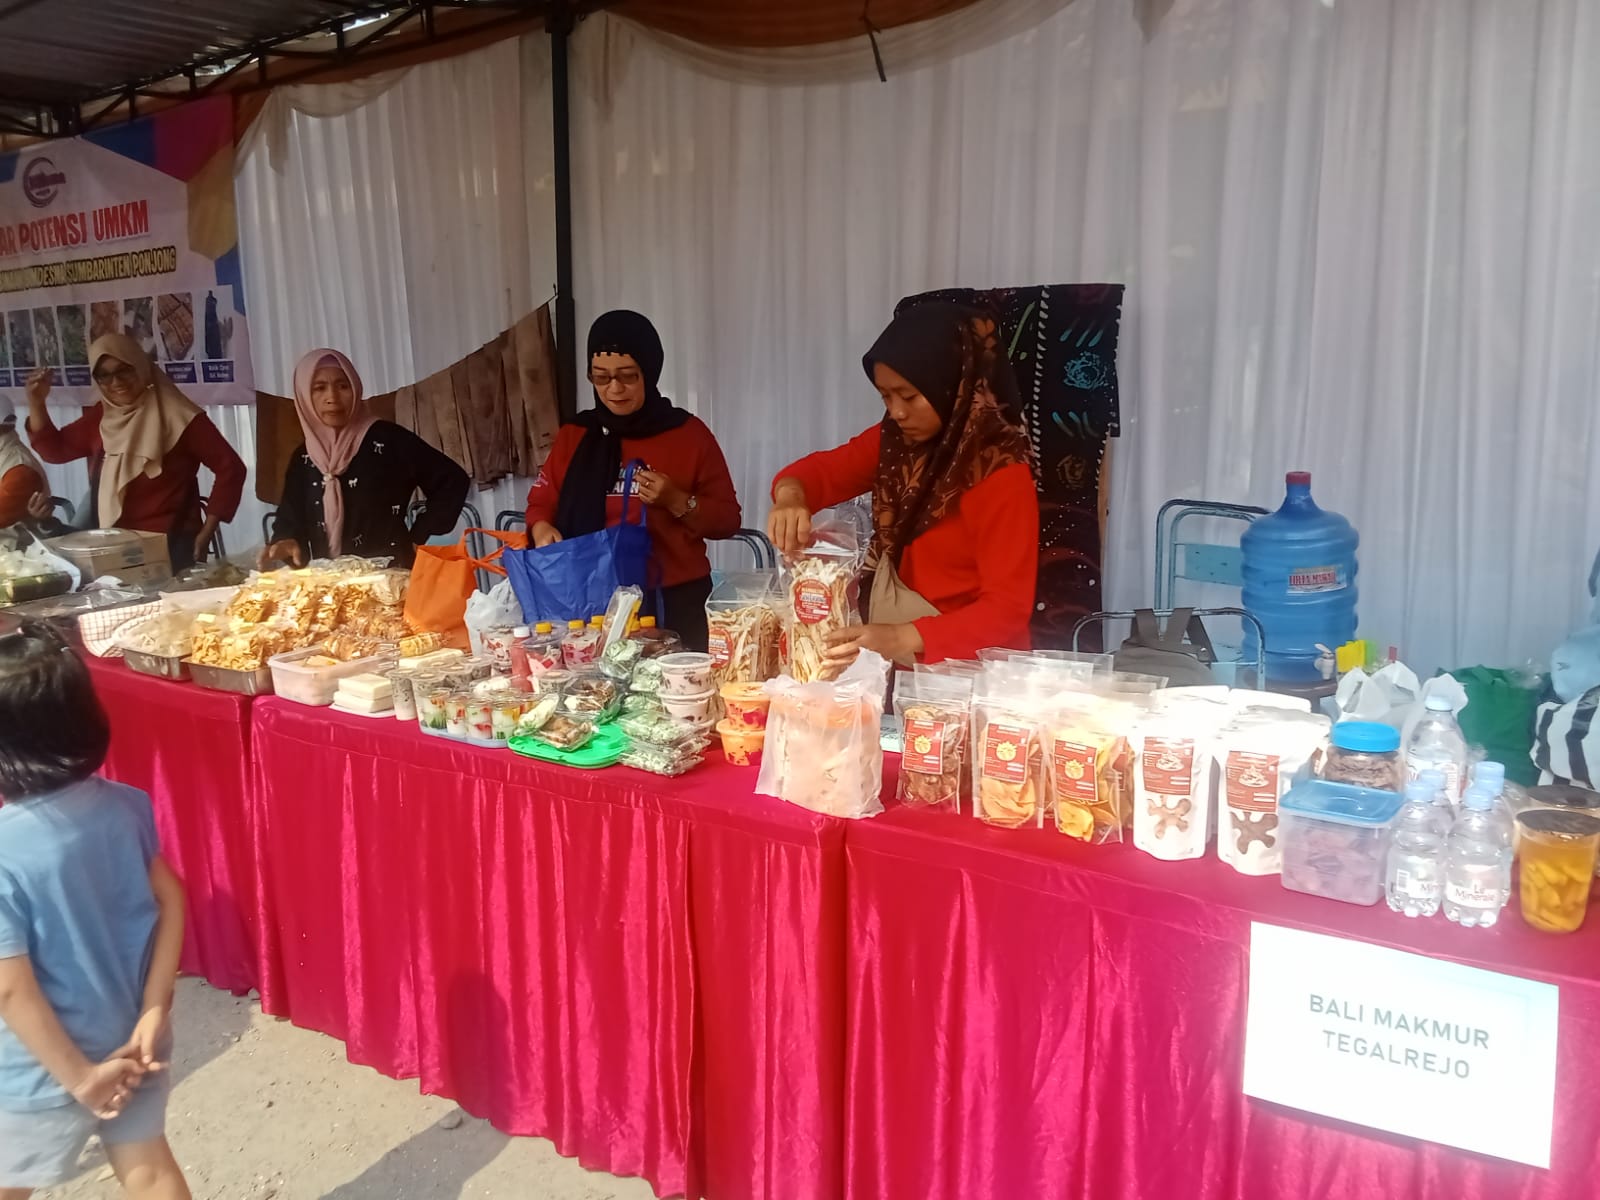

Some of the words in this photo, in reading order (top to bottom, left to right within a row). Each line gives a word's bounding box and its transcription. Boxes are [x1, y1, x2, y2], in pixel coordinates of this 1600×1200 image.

[19, 212, 87, 251] POTENSI
[93, 200, 149, 241] UMKM
[131, 246, 177, 277] PONJONG
[1309, 993, 1364, 1022] BALI
[1374, 1007, 1490, 1049] MAKMUR
[1322, 1029, 1471, 1079] TEGALREJO
